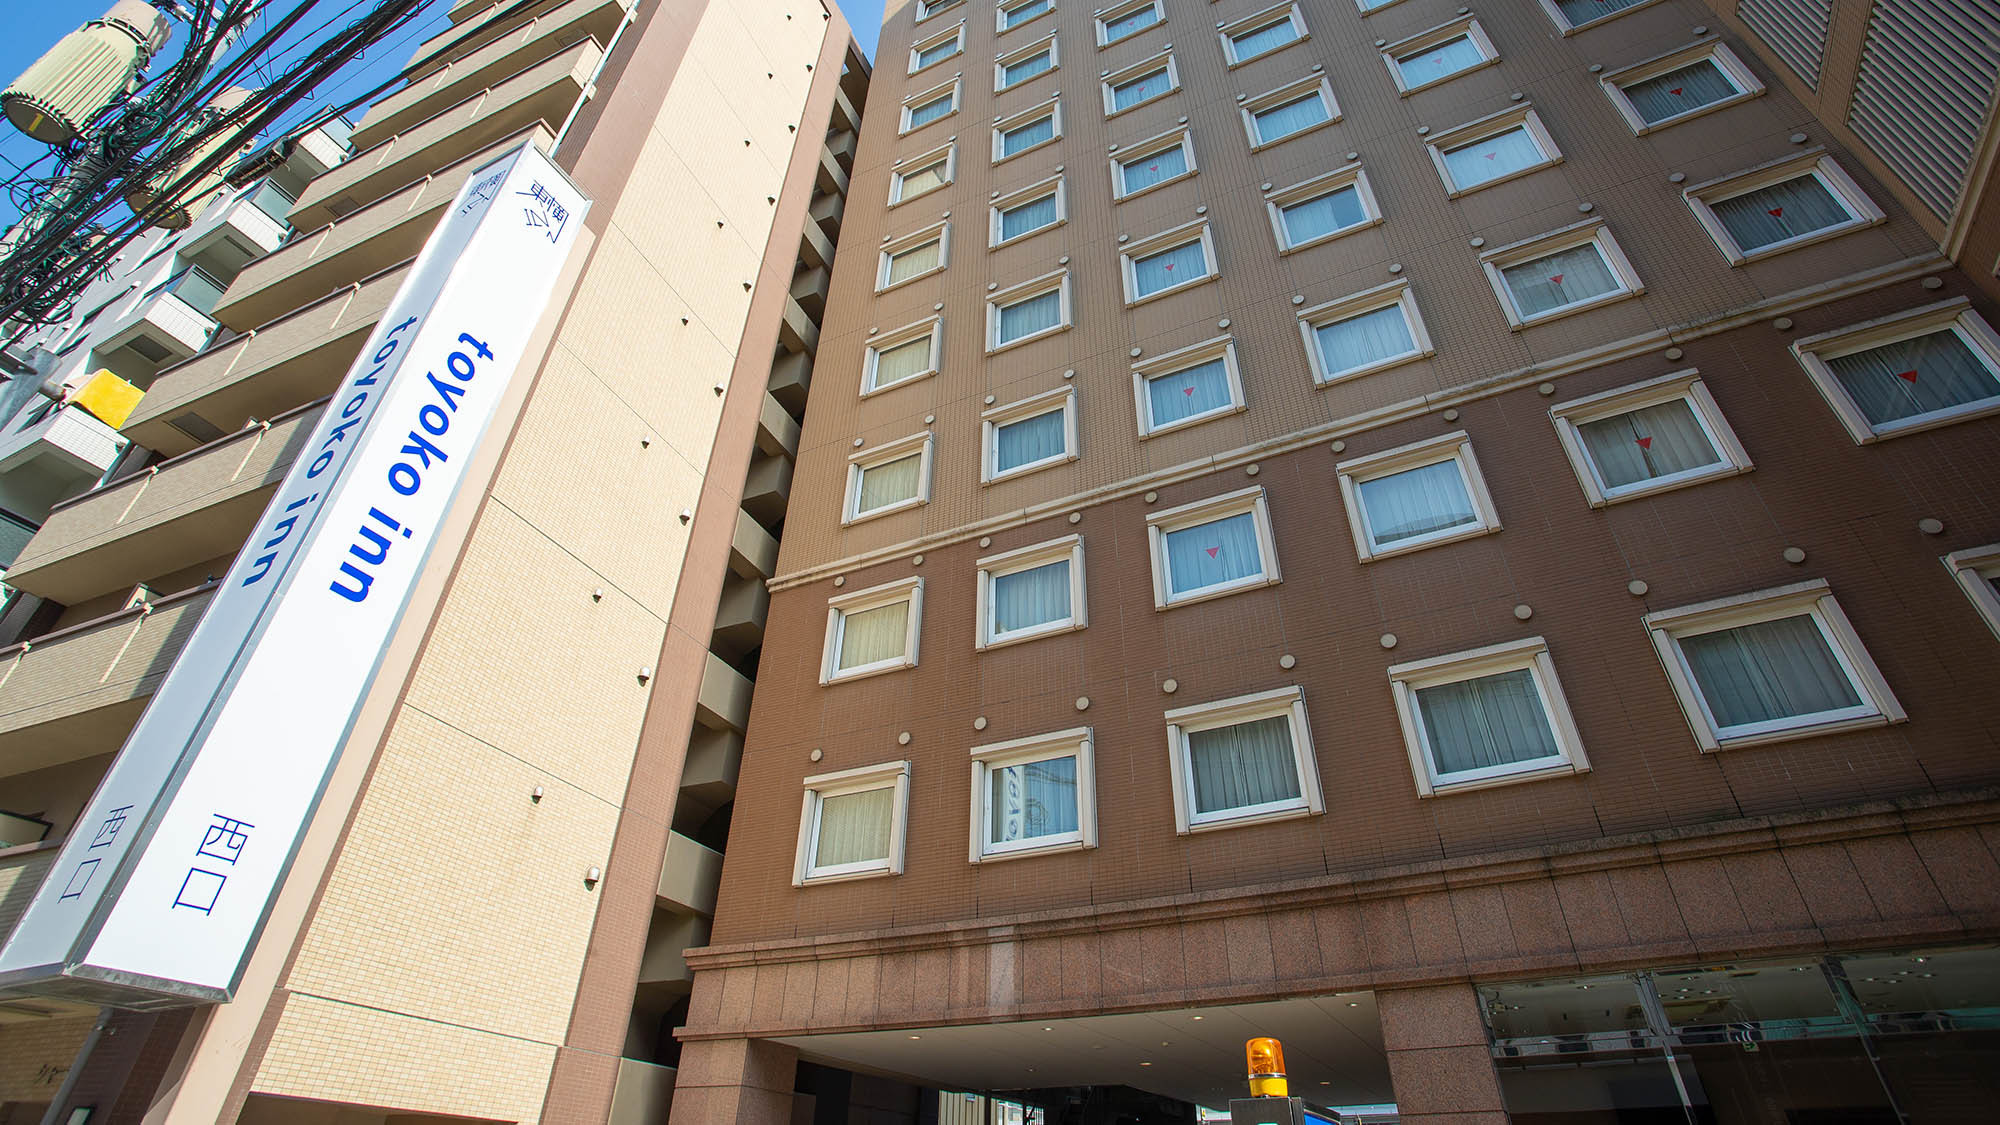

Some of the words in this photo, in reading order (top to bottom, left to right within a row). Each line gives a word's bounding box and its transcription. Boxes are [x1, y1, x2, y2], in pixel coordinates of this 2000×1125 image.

[306, 315, 418, 479] toyoko
[388, 332, 494, 496] toyoko
[241, 493, 319, 587] inn
[329, 506, 413, 603] inn
[57, 804, 135, 904] 西口
[172, 813, 256, 917] 西口
